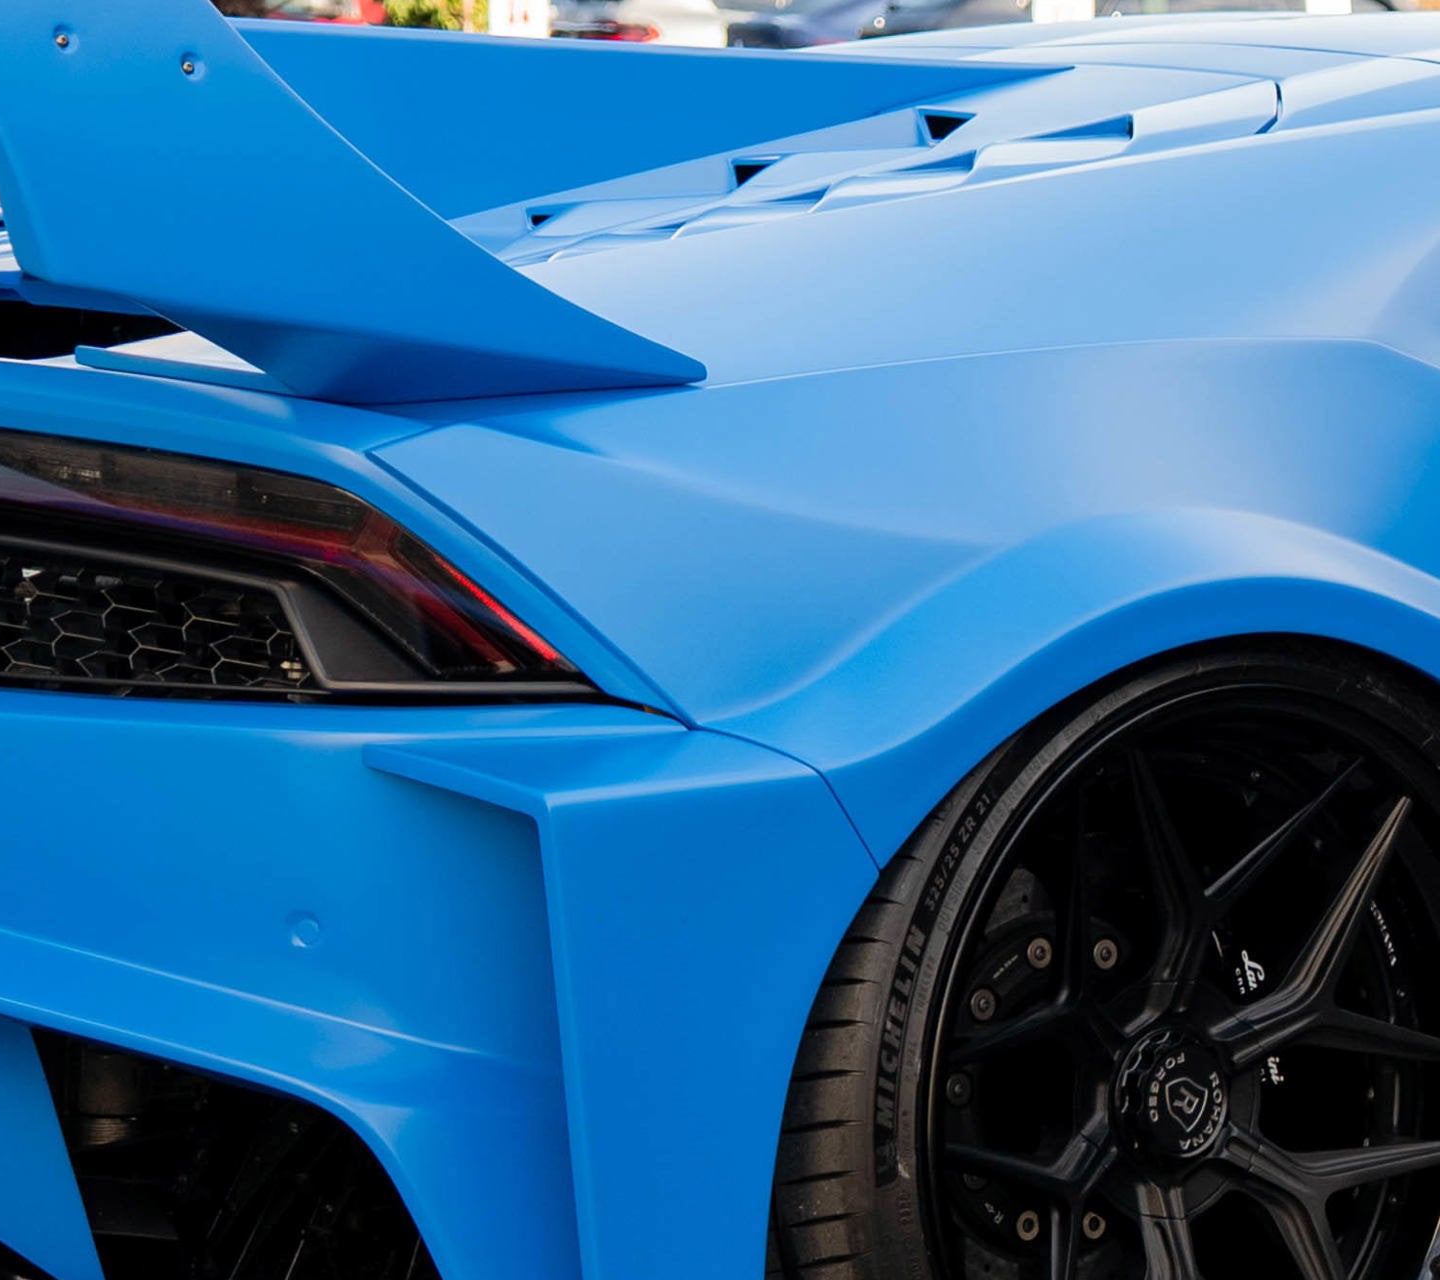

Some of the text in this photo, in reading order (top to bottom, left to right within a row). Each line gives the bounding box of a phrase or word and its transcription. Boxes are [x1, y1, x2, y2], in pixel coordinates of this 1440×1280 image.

[875, 923, 926, 1128] MICHELIN
[923, 842, 960, 912] 325/25
[958, 816, 977, 843] ZR
[1148, 1052, 1185, 1123] FORGED
[1179, 1071, 1223, 1151] ROHANA
